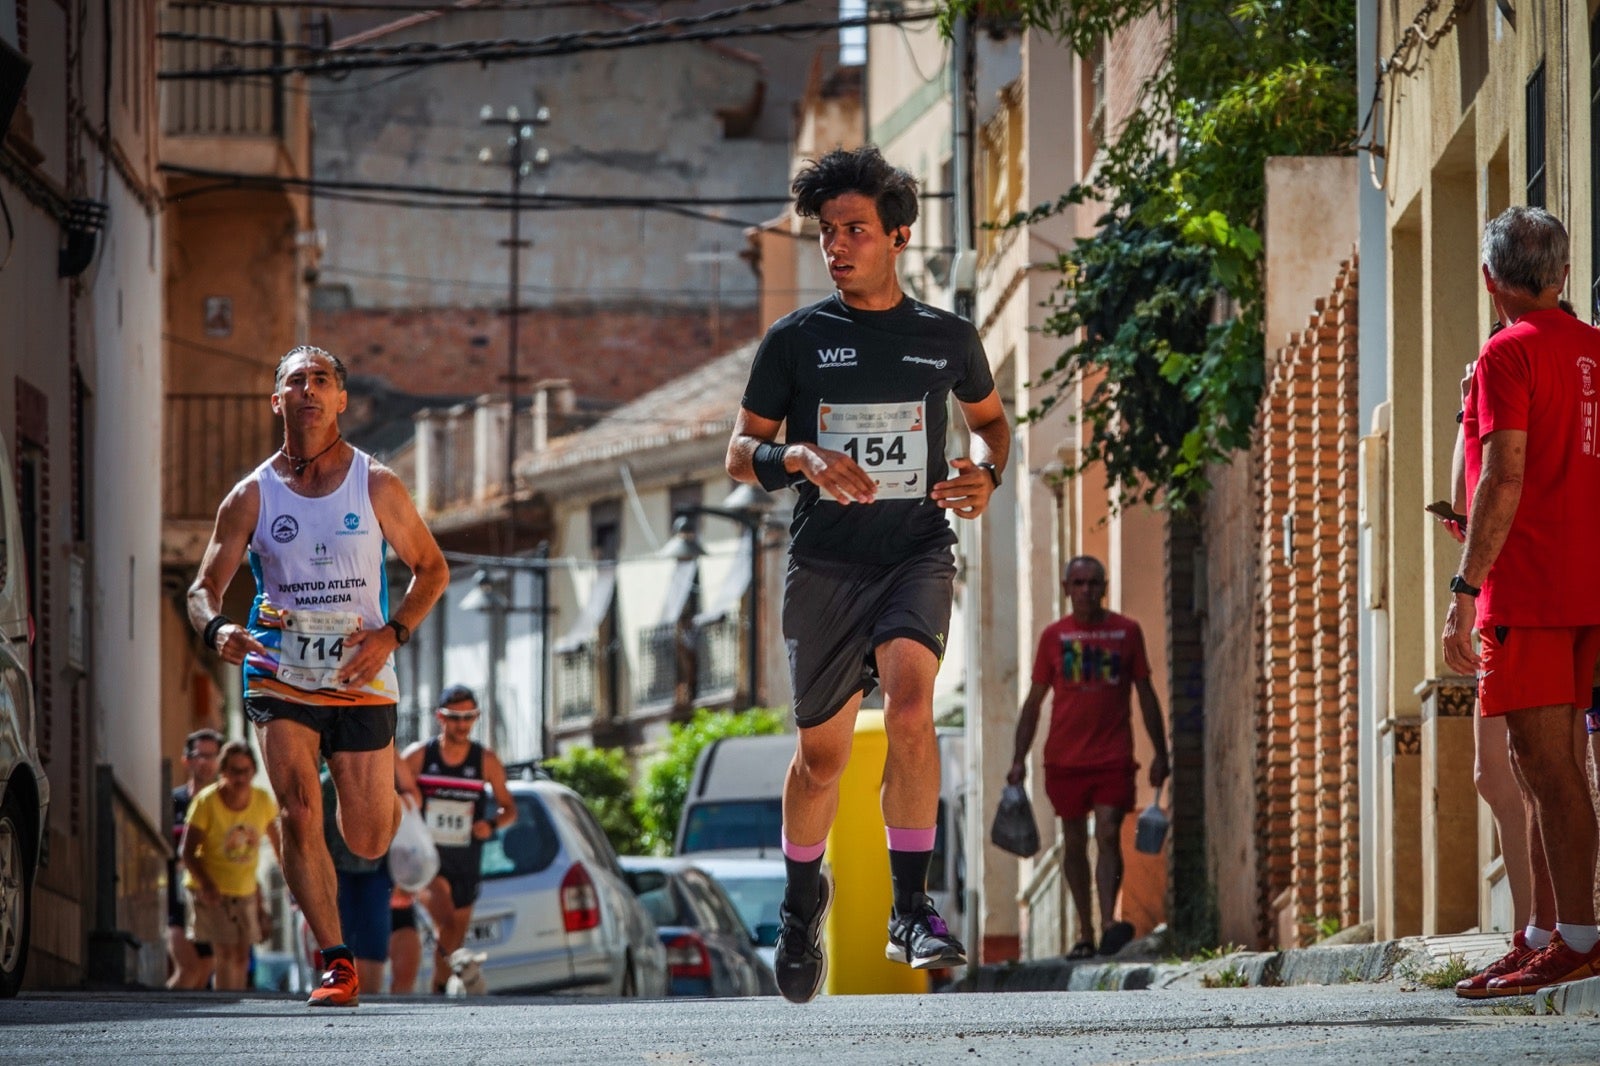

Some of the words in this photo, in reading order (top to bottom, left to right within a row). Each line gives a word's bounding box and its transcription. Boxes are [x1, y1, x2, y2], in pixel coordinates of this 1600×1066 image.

[817, 347, 857, 363] WP
[843, 435, 907, 467] 154
[344, 516, 360, 527] SIC
[278, 580, 327, 593] JUVENTUD
[328, 576, 367, 589] ATLÉTICA
[294, 592, 352, 606] MARACENA
[297, 635, 344, 662] 714
